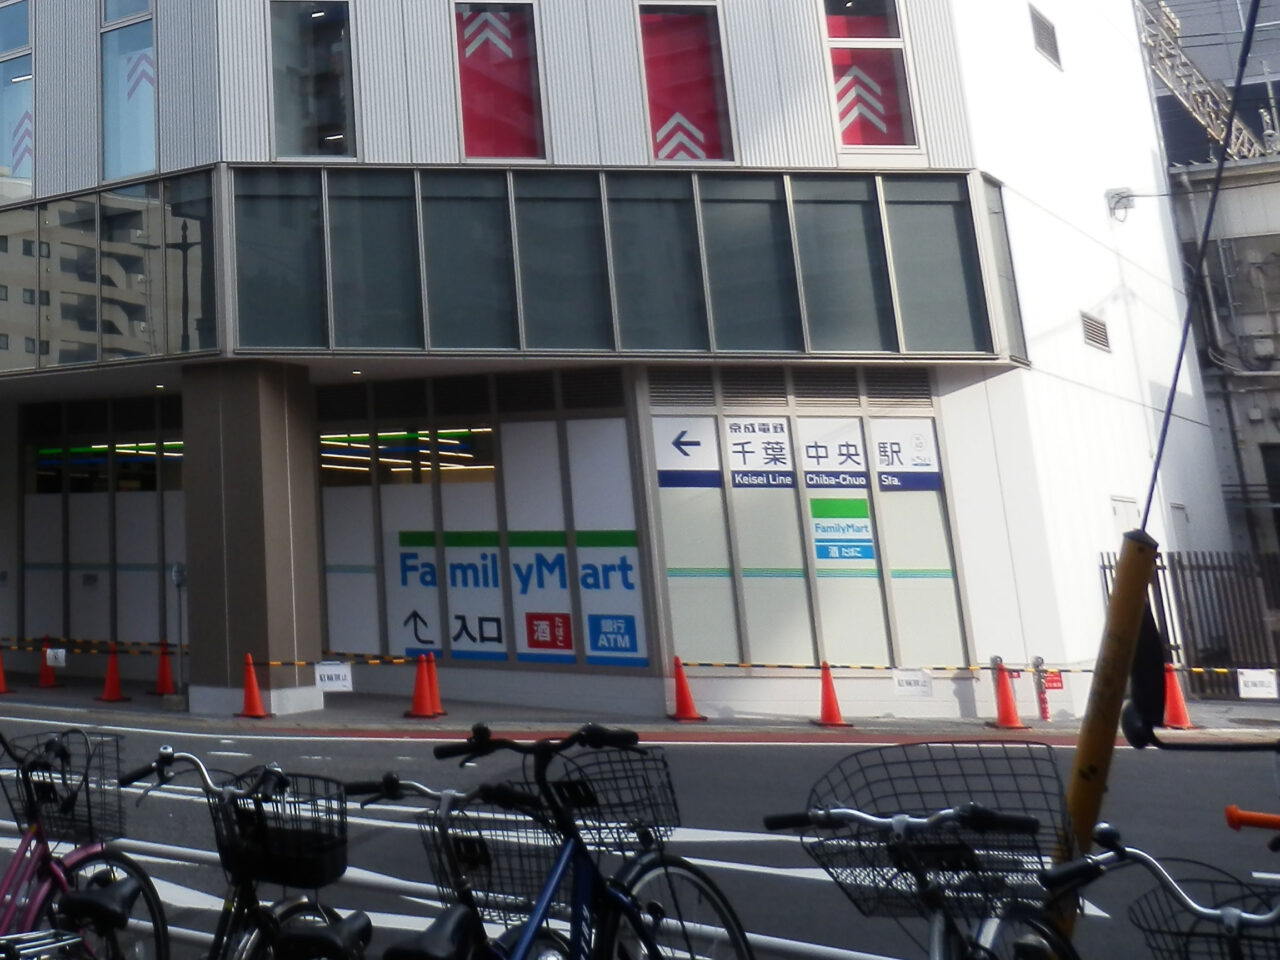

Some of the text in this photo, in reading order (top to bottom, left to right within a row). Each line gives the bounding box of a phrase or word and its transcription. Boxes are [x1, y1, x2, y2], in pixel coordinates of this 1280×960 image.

[734, 473, 767, 484] Keisei
[769, 473, 793, 485] Line
[806, 474, 867, 486] Chiba-Chuo
[814, 522, 870, 535] FamilyMart
[400, 552, 636, 595] FamilyMart
[452, 614, 503, 644] 入口
[532, 620, 551, 642] 酒
[600, 619, 625, 633] 銀行
[597, 634, 631, 649] ATM
